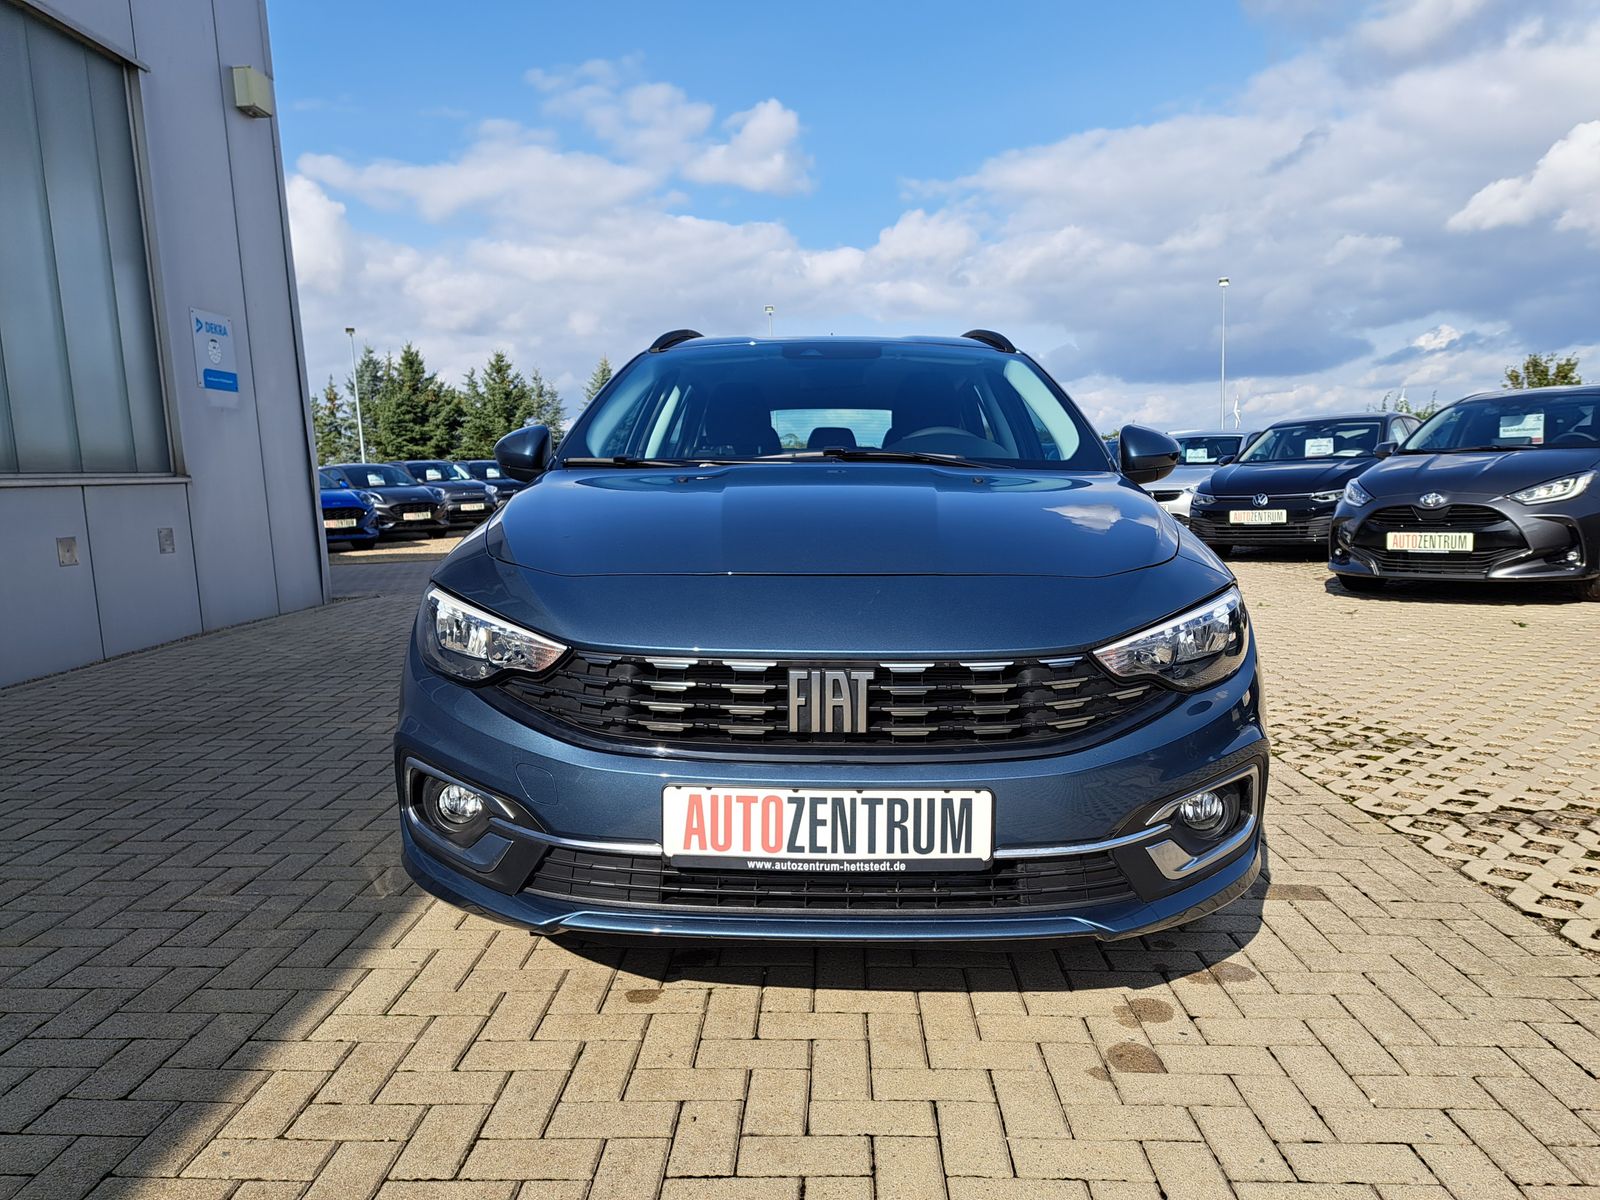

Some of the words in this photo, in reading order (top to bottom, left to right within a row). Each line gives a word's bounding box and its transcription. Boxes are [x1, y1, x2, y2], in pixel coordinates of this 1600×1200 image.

[205, 321, 228, 337] DEKRA
[1233, 511, 1284, 521] AUTOZENTRUM
[1392, 534, 1467, 549] AUTOZENTRUM
[788, 669, 874, 733] FIAT
[683, 794, 973, 855] AUTOZENTRUM
[747, 859, 906, 872] www.autozentrum-hettstedt.de
